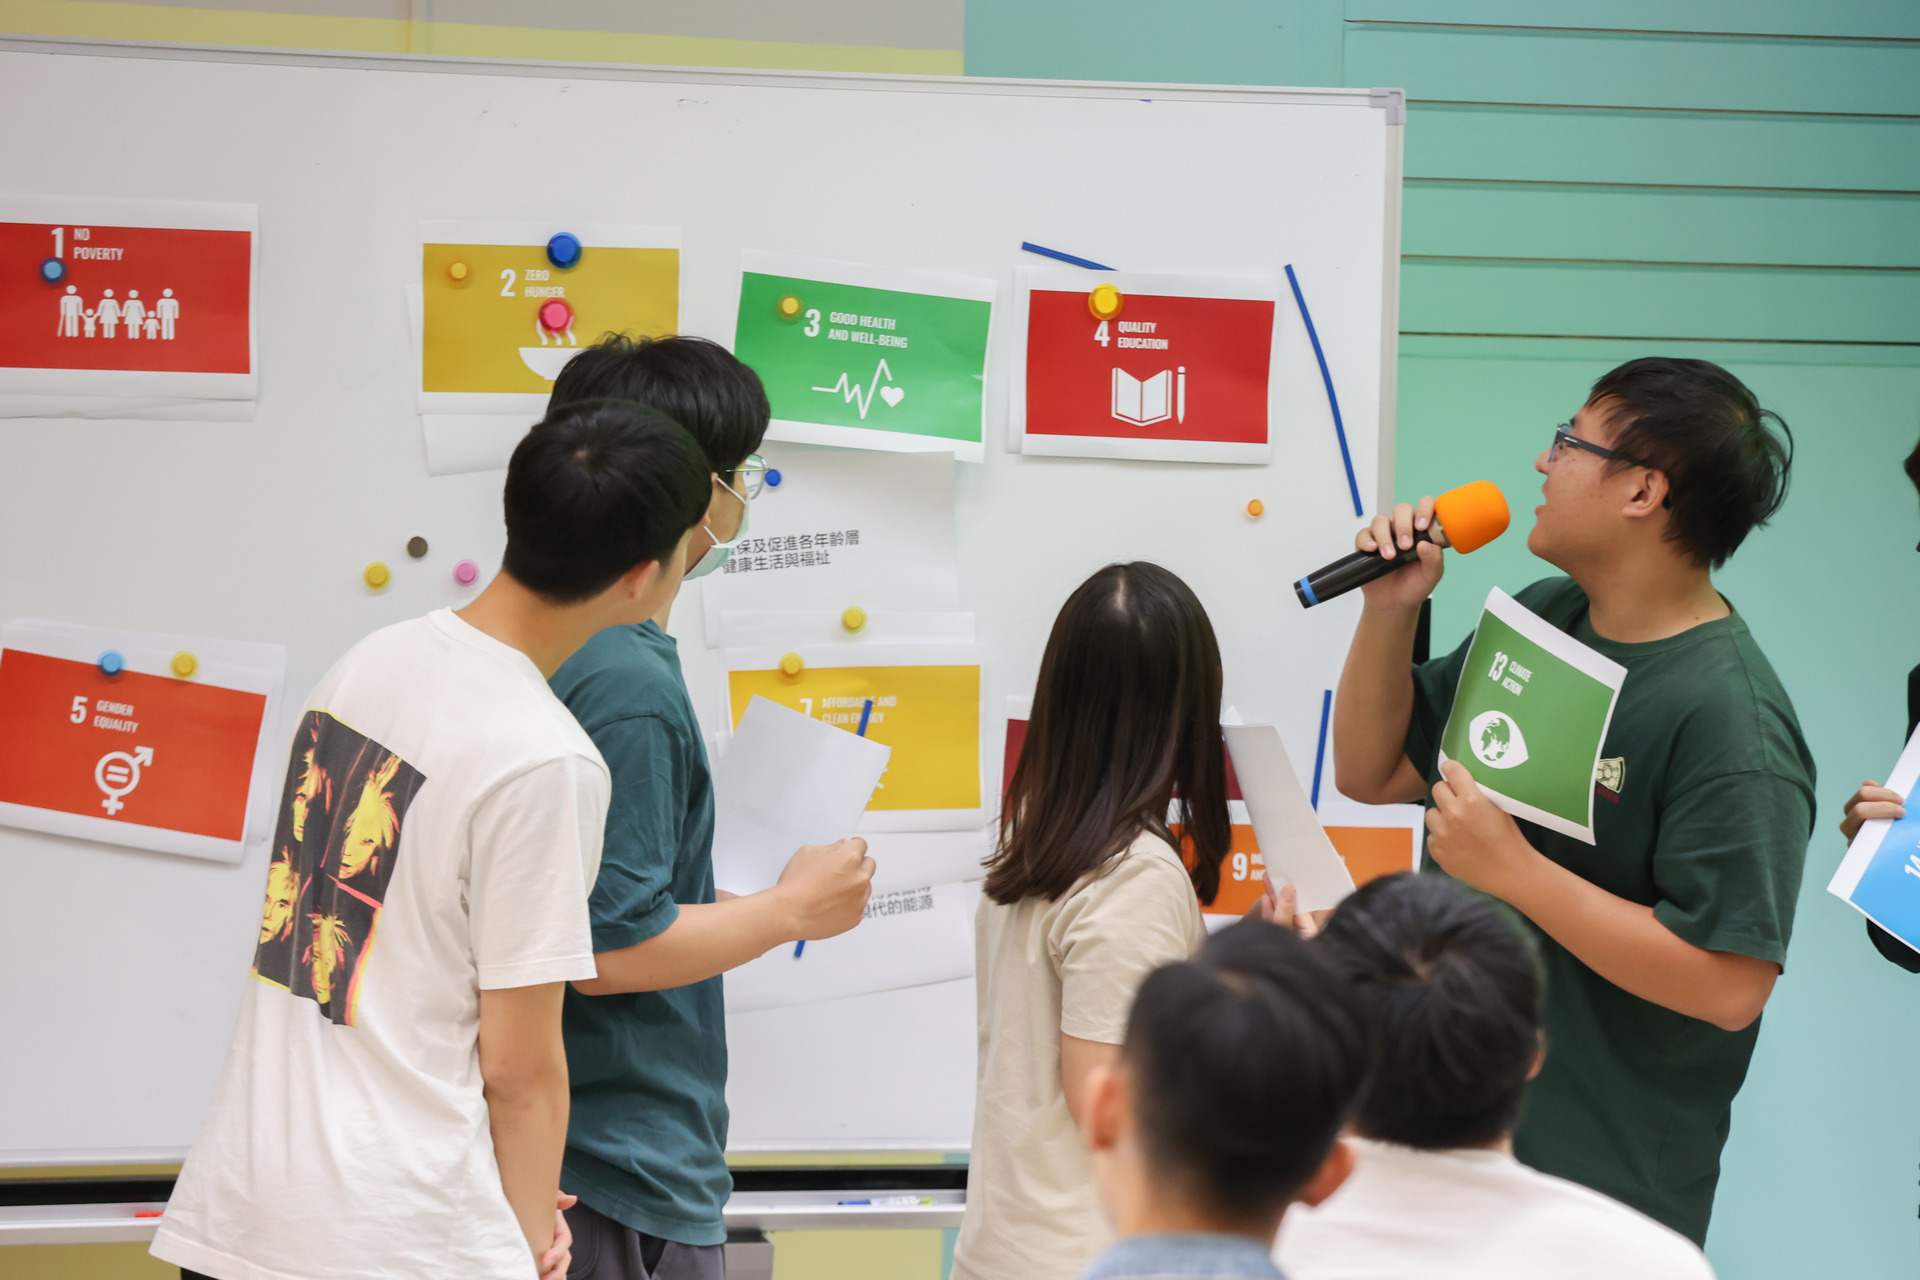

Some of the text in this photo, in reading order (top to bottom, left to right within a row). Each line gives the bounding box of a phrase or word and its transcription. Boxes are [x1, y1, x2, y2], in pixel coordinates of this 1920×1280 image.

[51, 227, 64, 259] 1
[73, 228, 90, 241] NO
[73, 246, 124, 261] POVERTY
[500, 268, 516, 297] 2
[524, 269, 550, 281] ZERO
[524, 286, 565, 298] HUNGER
[803, 308, 821, 338] 3
[829, 311, 896, 331] GOOD HEALTH
[1118, 321, 1157, 334] QUALITY
[828, 328, 908, 349] AND WELL-BEING
[1093, 320, 1111, 347] 4
[1117, 337, 1169, 350] EDUCATION
[730, 529, 860, 556] 保及促進各年齡層
[723, 550, 831, 574] 健康生活與福祉
[1488, 651, 1509, 681] 13
[1508, 660, 1533, 683] CLIMATE
[1501, 676, 1524, 696] ACTION
[69, 695, 88, 724] 5
[96, 699, 134, 717] GENDER
[799, 697, 814, 718] 7
[877, 695, 898, 708] AND
[93, 714, 139, 734] EQUALITY
[822, 711, 885, 725] CLEAN ENRGY
[1232, 852, 1248, 881] 9
